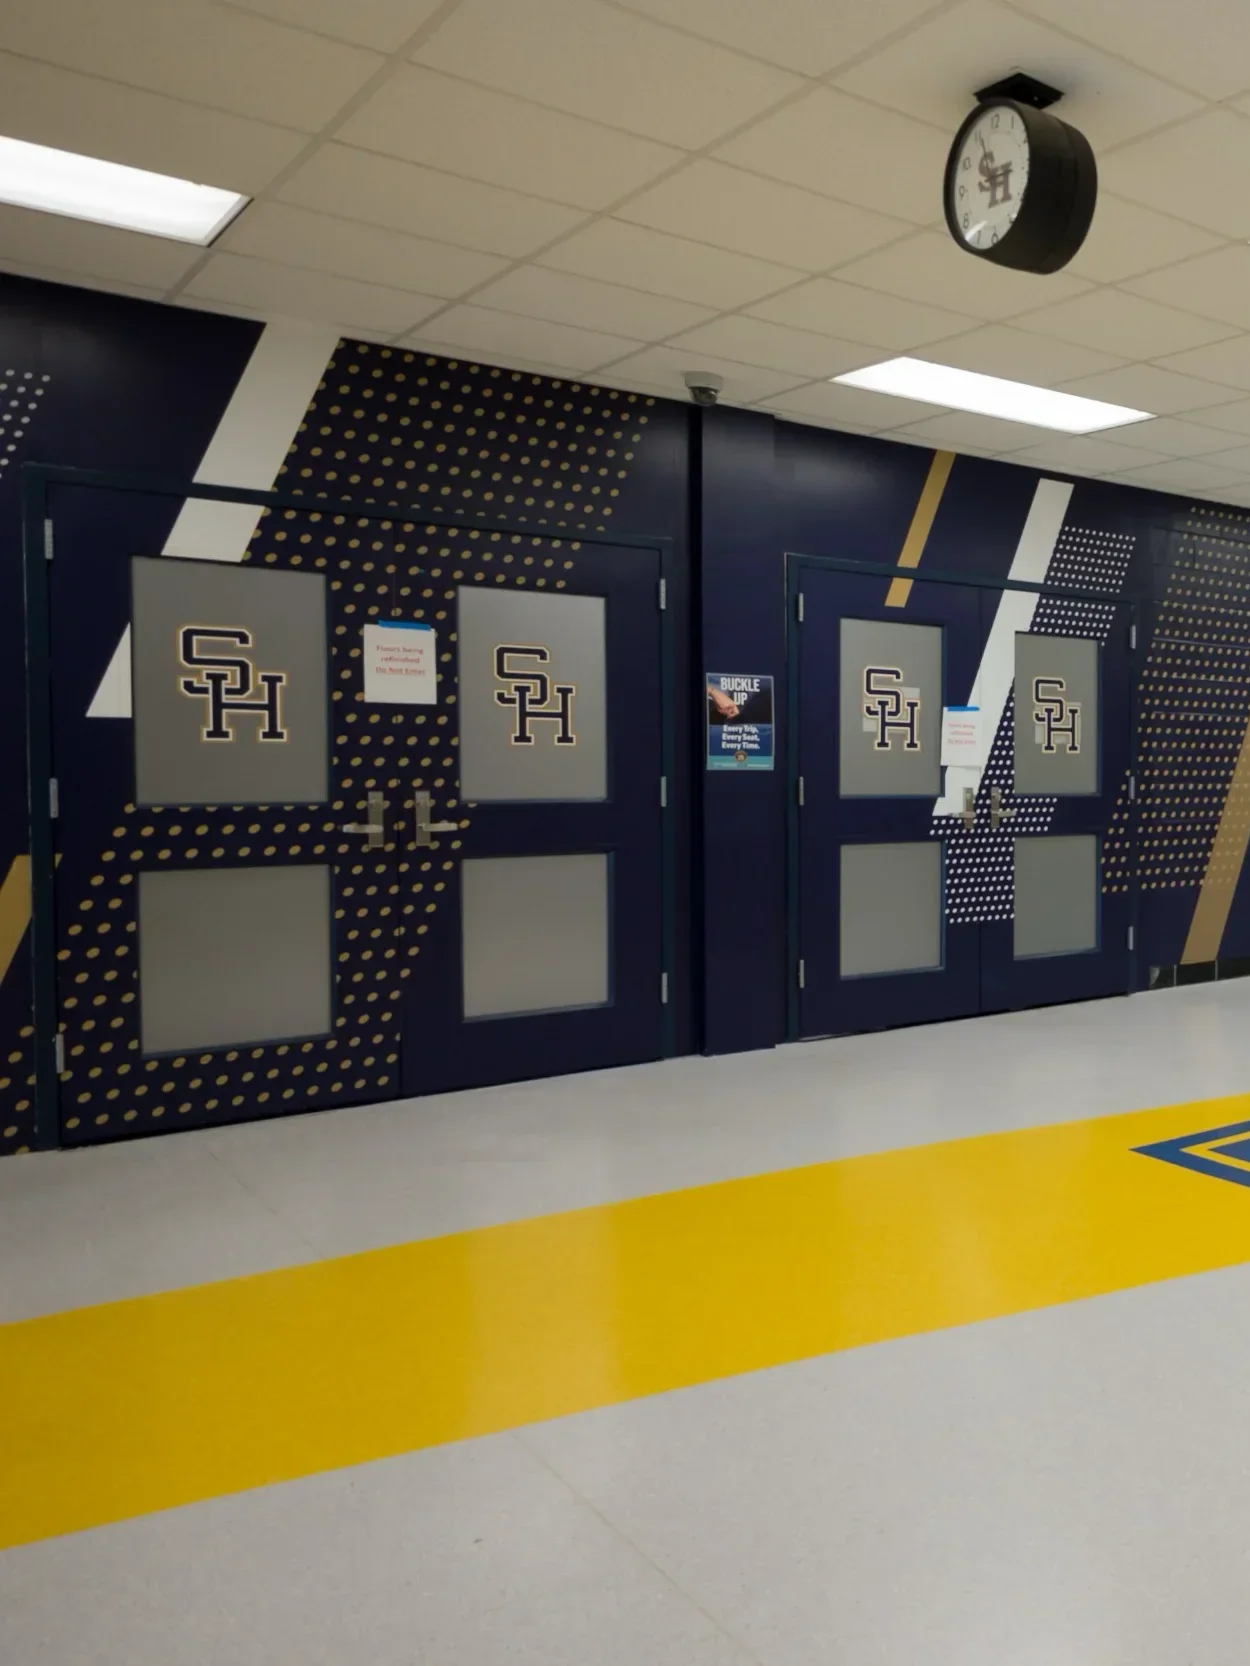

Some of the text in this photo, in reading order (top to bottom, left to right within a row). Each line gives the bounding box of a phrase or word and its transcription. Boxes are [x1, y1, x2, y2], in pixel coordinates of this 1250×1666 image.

[720, 676, 760, 692] BUCKLE
[733, 692, 748, 706] UP
[723, 725, 742, 733] Every
[722, 733, 742, 742] Every
[722, 741, 741, 750] Every
